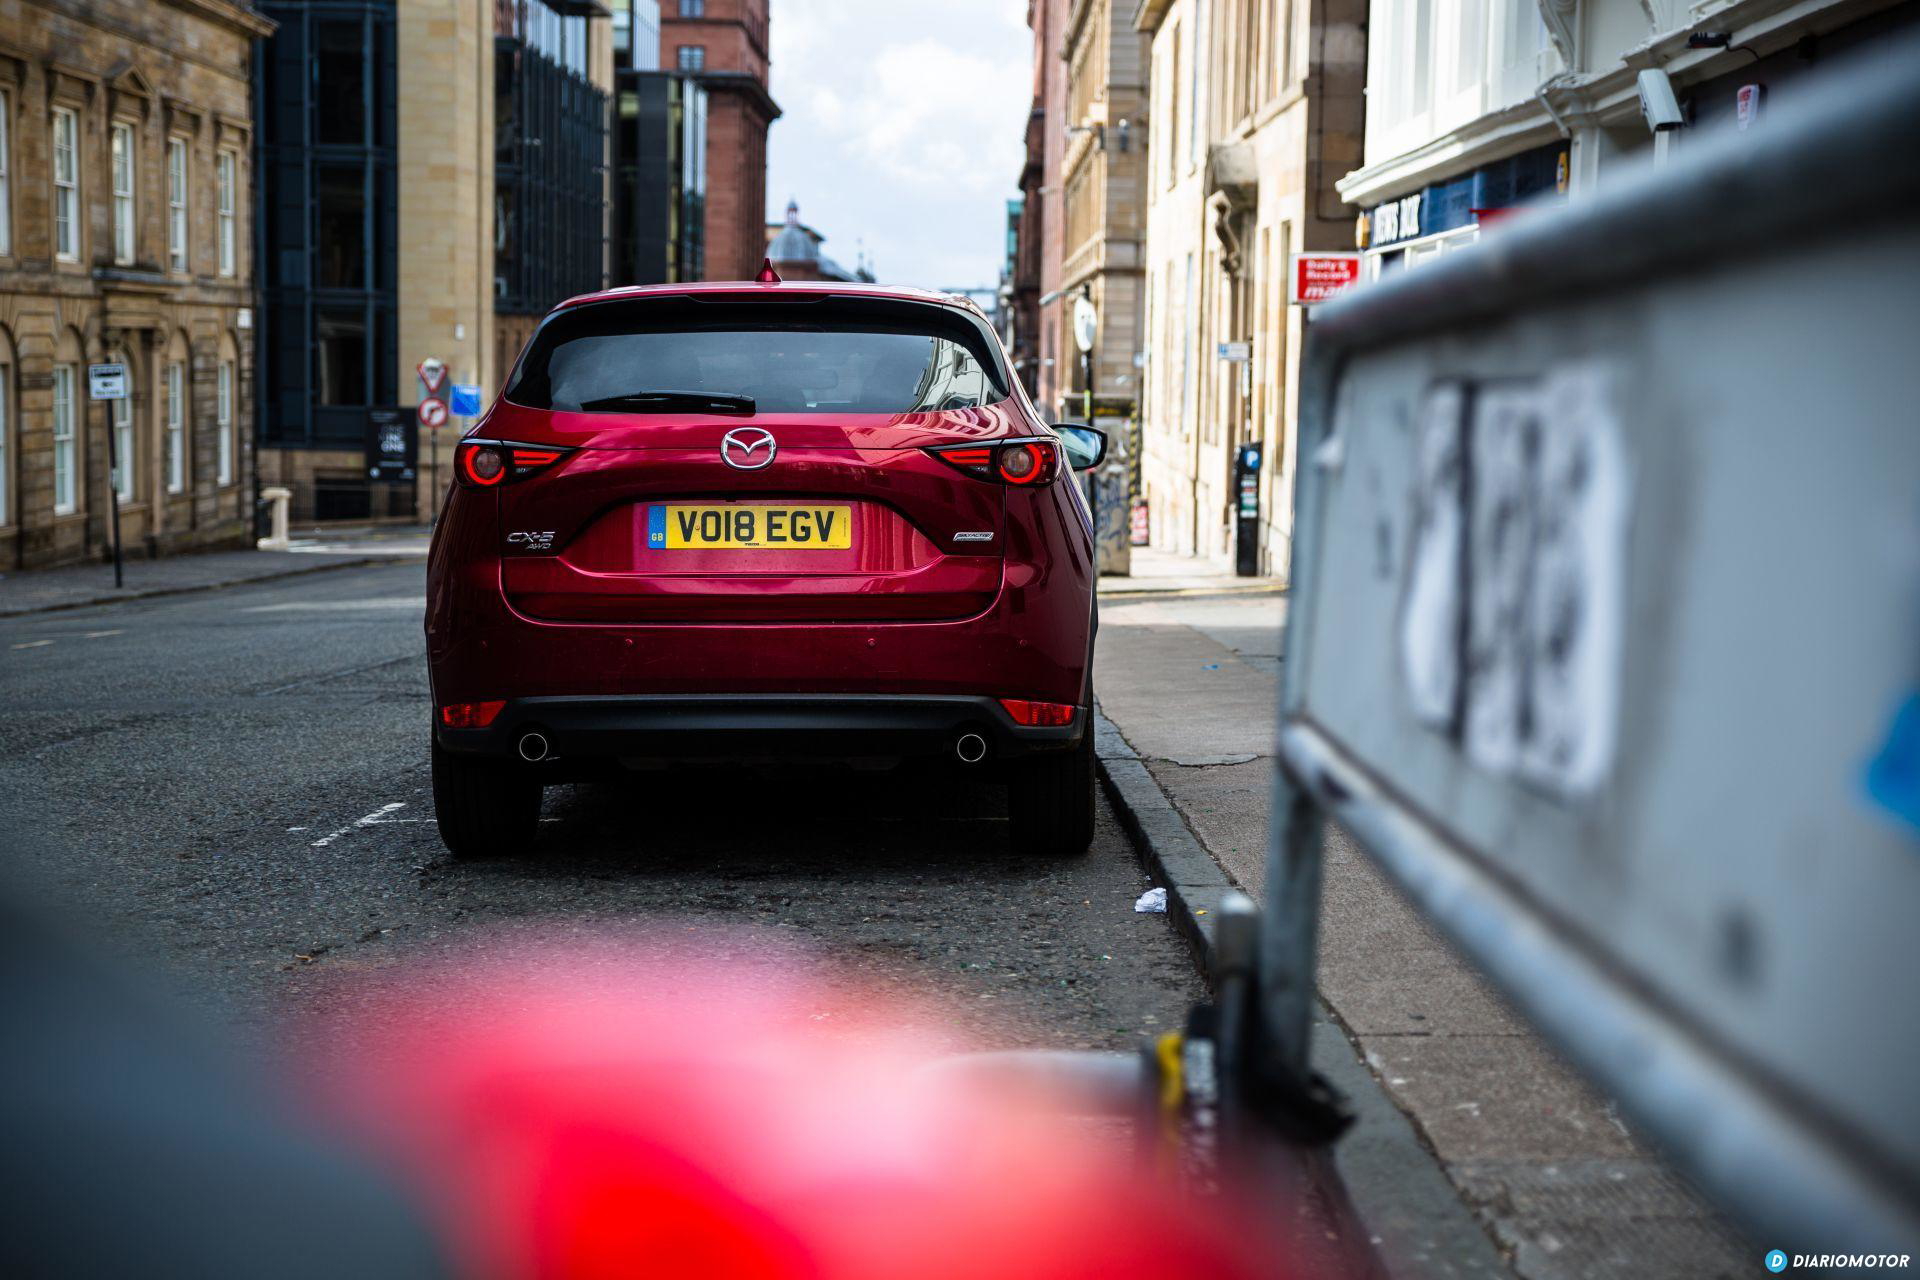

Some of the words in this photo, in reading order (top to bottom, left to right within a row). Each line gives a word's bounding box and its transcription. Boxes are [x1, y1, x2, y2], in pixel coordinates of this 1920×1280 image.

[677, 510, 755, 542] VO18
[766, 510, 834, 542] EGV
[507, 531, 555, 542] CX-5
[651, 532, 664, 542] GB
